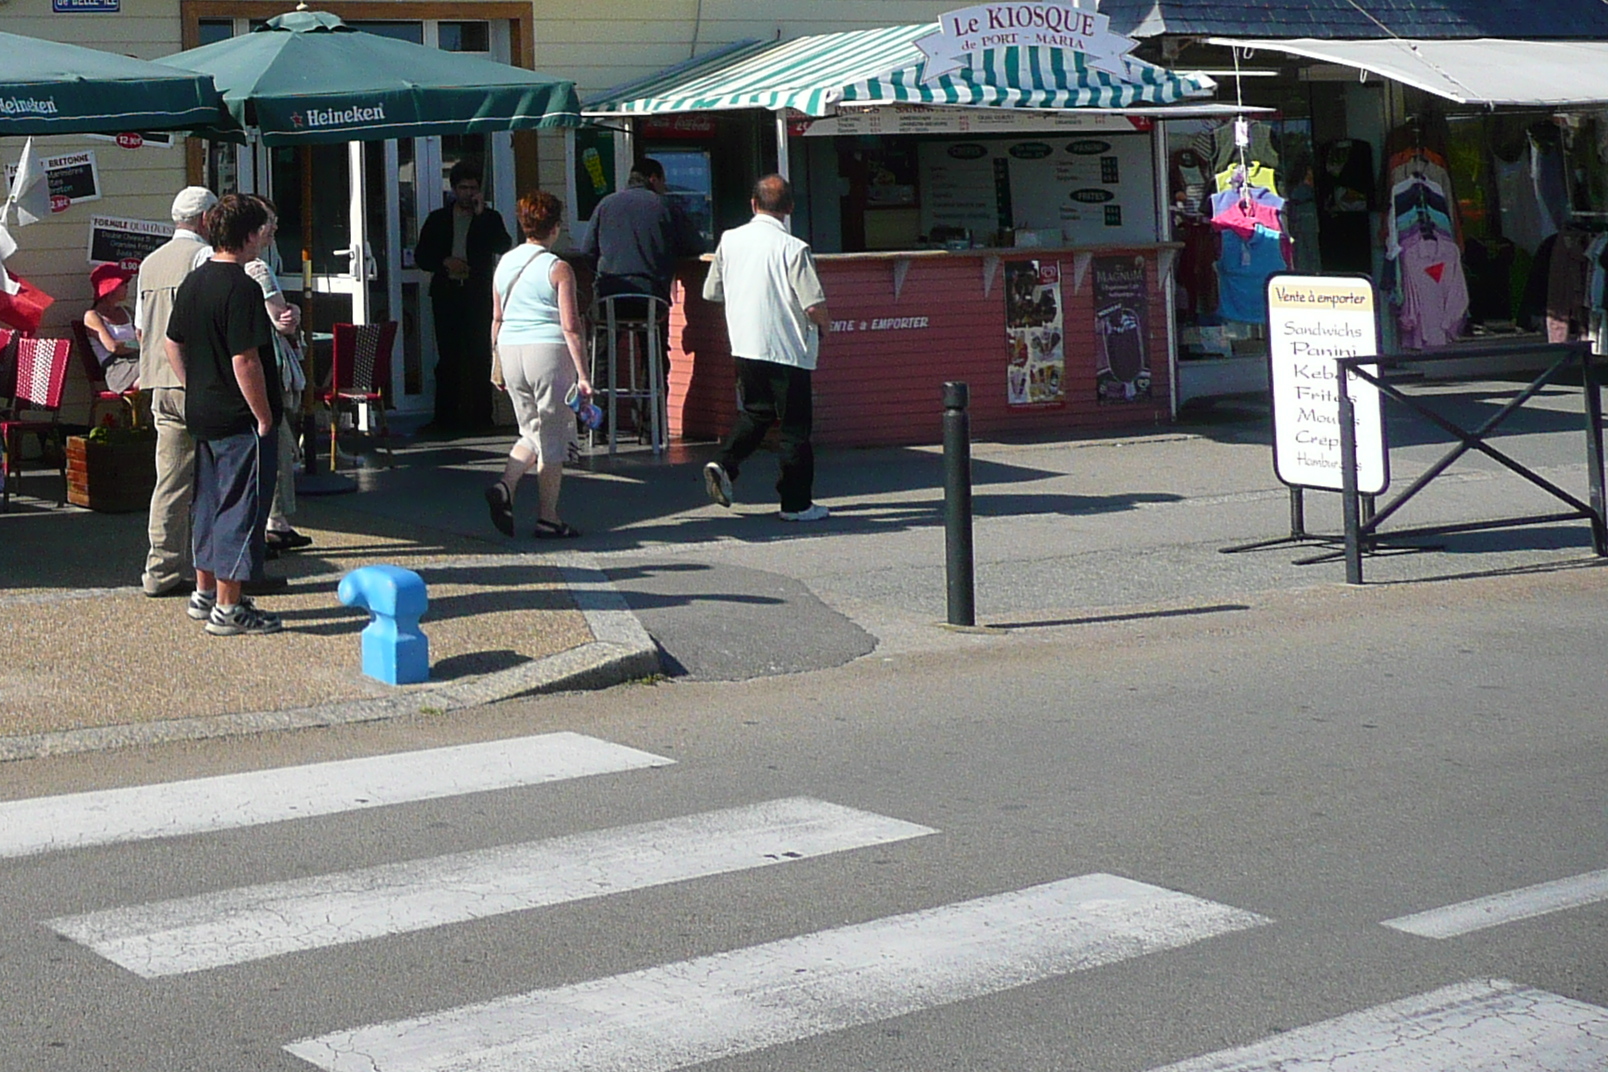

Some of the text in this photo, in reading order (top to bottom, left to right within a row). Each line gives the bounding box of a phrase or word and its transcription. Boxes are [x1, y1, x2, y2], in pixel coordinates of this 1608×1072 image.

[953, 4, 1096, 38] Le KIOSQUE
[961, 39, 978, 52] de
[980, 32, 1020, 48] PORT
[1034, 32, 1086, 51] MARIA
[306, 105, 386, 127] Heineken
[48, 154, 89, 168] BRETONNE
[93, 217, 128, 230] FORMULE
[1274, 286, 1367, 309] Vente à emporter
[828, 319, 856, 332] ENTE
[871, 316, 930, 330] EMPORTER
[1282, 320, 1363, 338] Sandwichs
[1289, 341, 1357, 358] Panini
